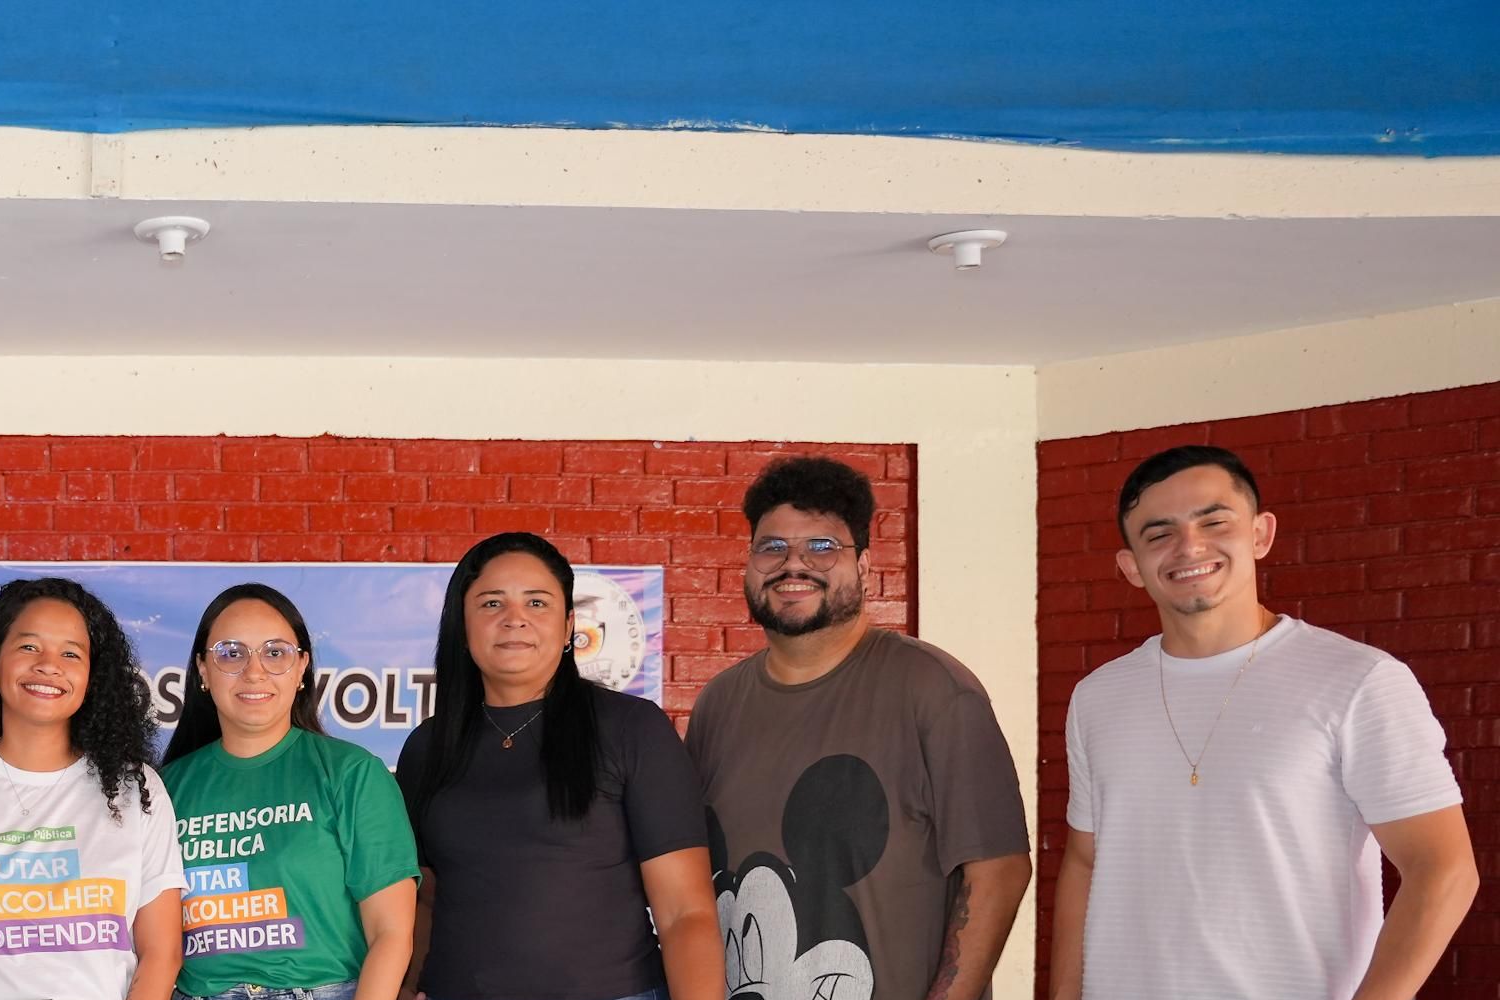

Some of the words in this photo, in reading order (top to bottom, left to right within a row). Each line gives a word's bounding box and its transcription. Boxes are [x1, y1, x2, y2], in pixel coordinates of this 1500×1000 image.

[33, 828, 73, 841] Pública
[181, 832, 266, 862] ÚBLICA
[182, 893, 280, 927] ACOLHER
[185, 923, 297, 956] DEFENDER
